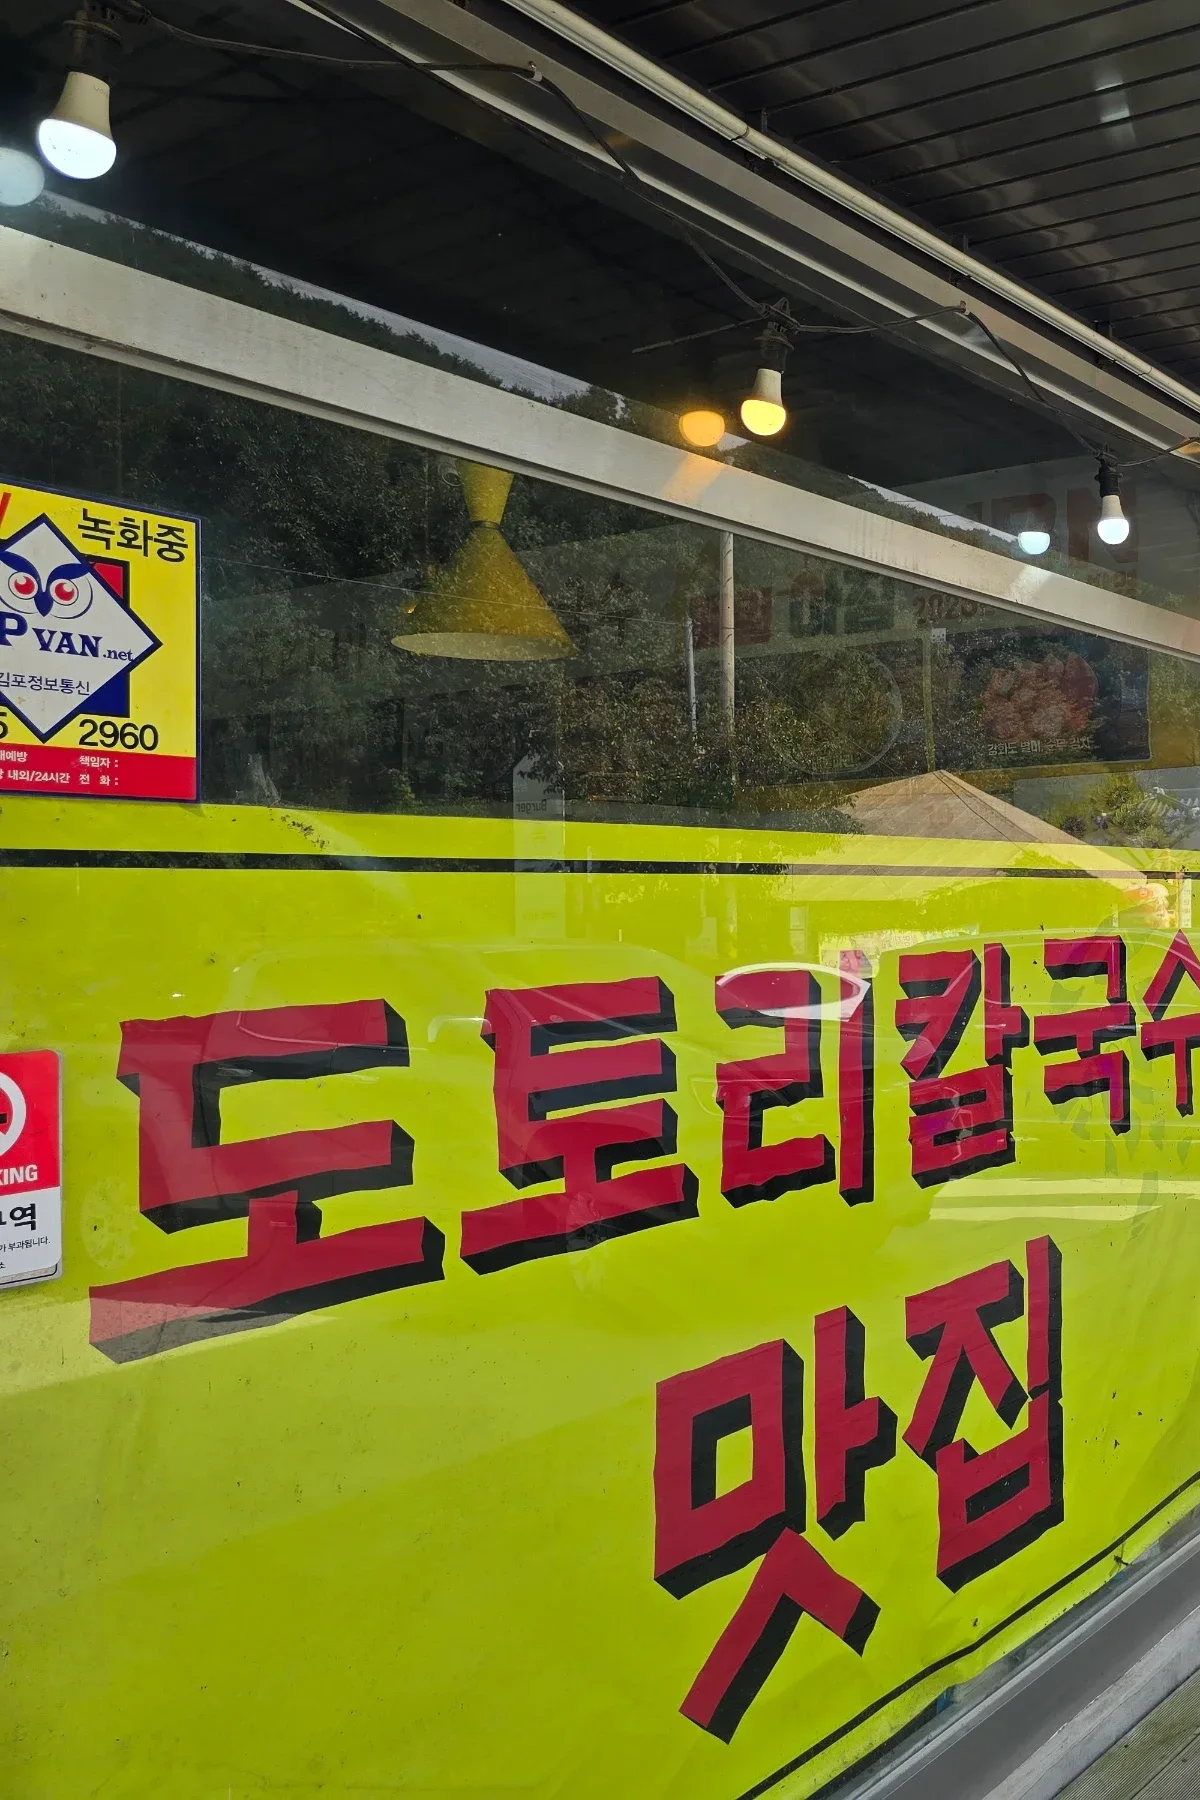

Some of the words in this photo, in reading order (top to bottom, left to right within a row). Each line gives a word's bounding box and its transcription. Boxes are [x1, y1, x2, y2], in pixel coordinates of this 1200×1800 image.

[78, 508, 188, 562] 녹화중
[0, 672, 90, 696] 김포정보통신
[79, 719, 159, 751] 2960
[79, 755, 110, 769] 책임자
[8, 770, 70, 784] 내외/24시간
[653, 1235, 1064, 1744] 맛집
